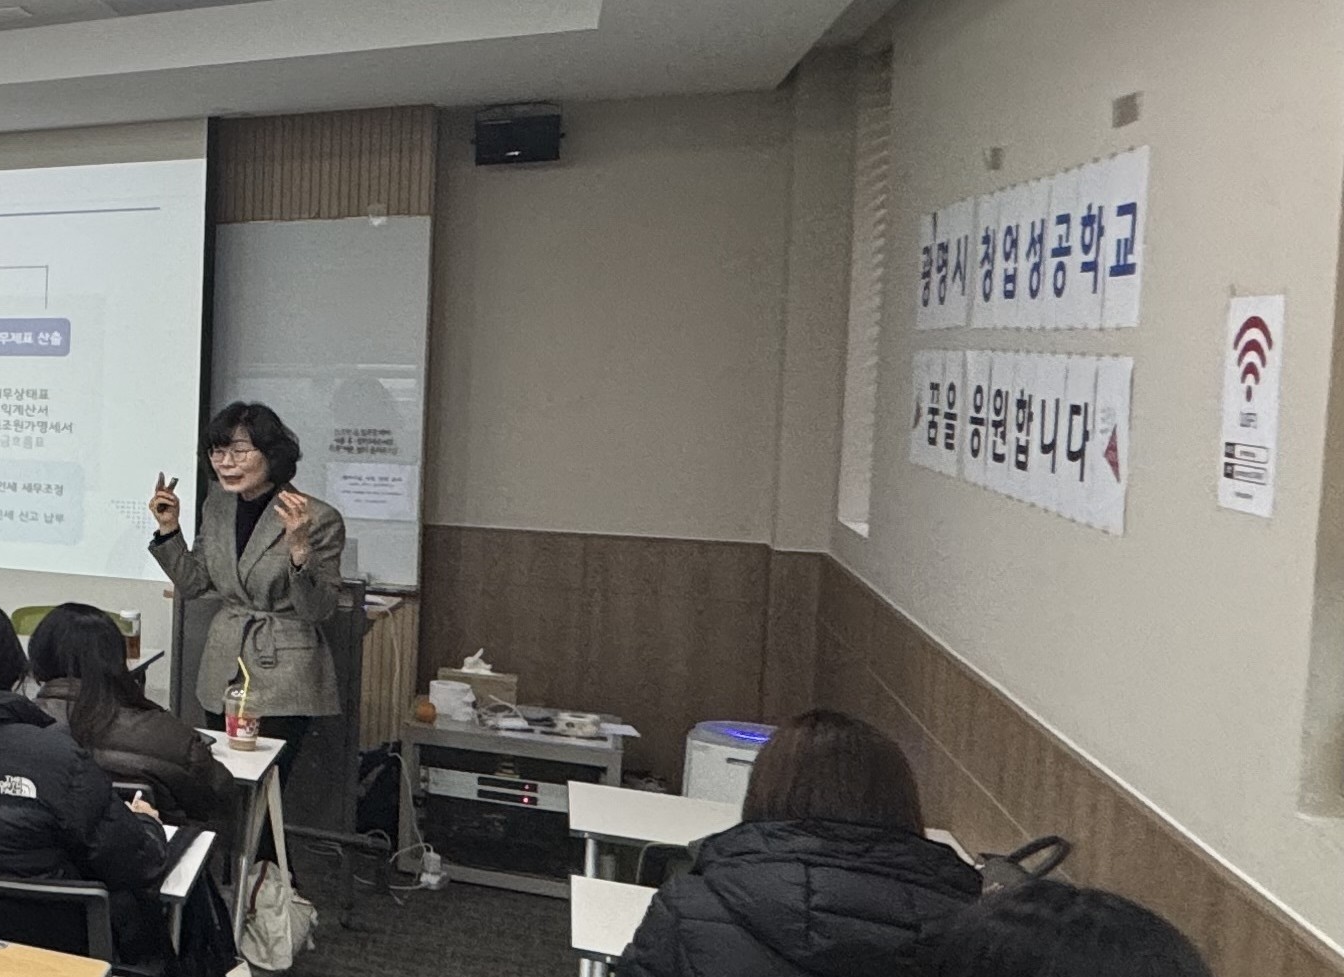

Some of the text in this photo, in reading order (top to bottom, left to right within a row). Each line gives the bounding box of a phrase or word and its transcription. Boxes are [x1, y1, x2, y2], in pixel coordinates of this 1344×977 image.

[920, 201, 1138, 308] 광명시 창업성공학교
[37, 331, 63, 346] 산출
[926, 381, 1091, 483] 꿈을 응원합니다
